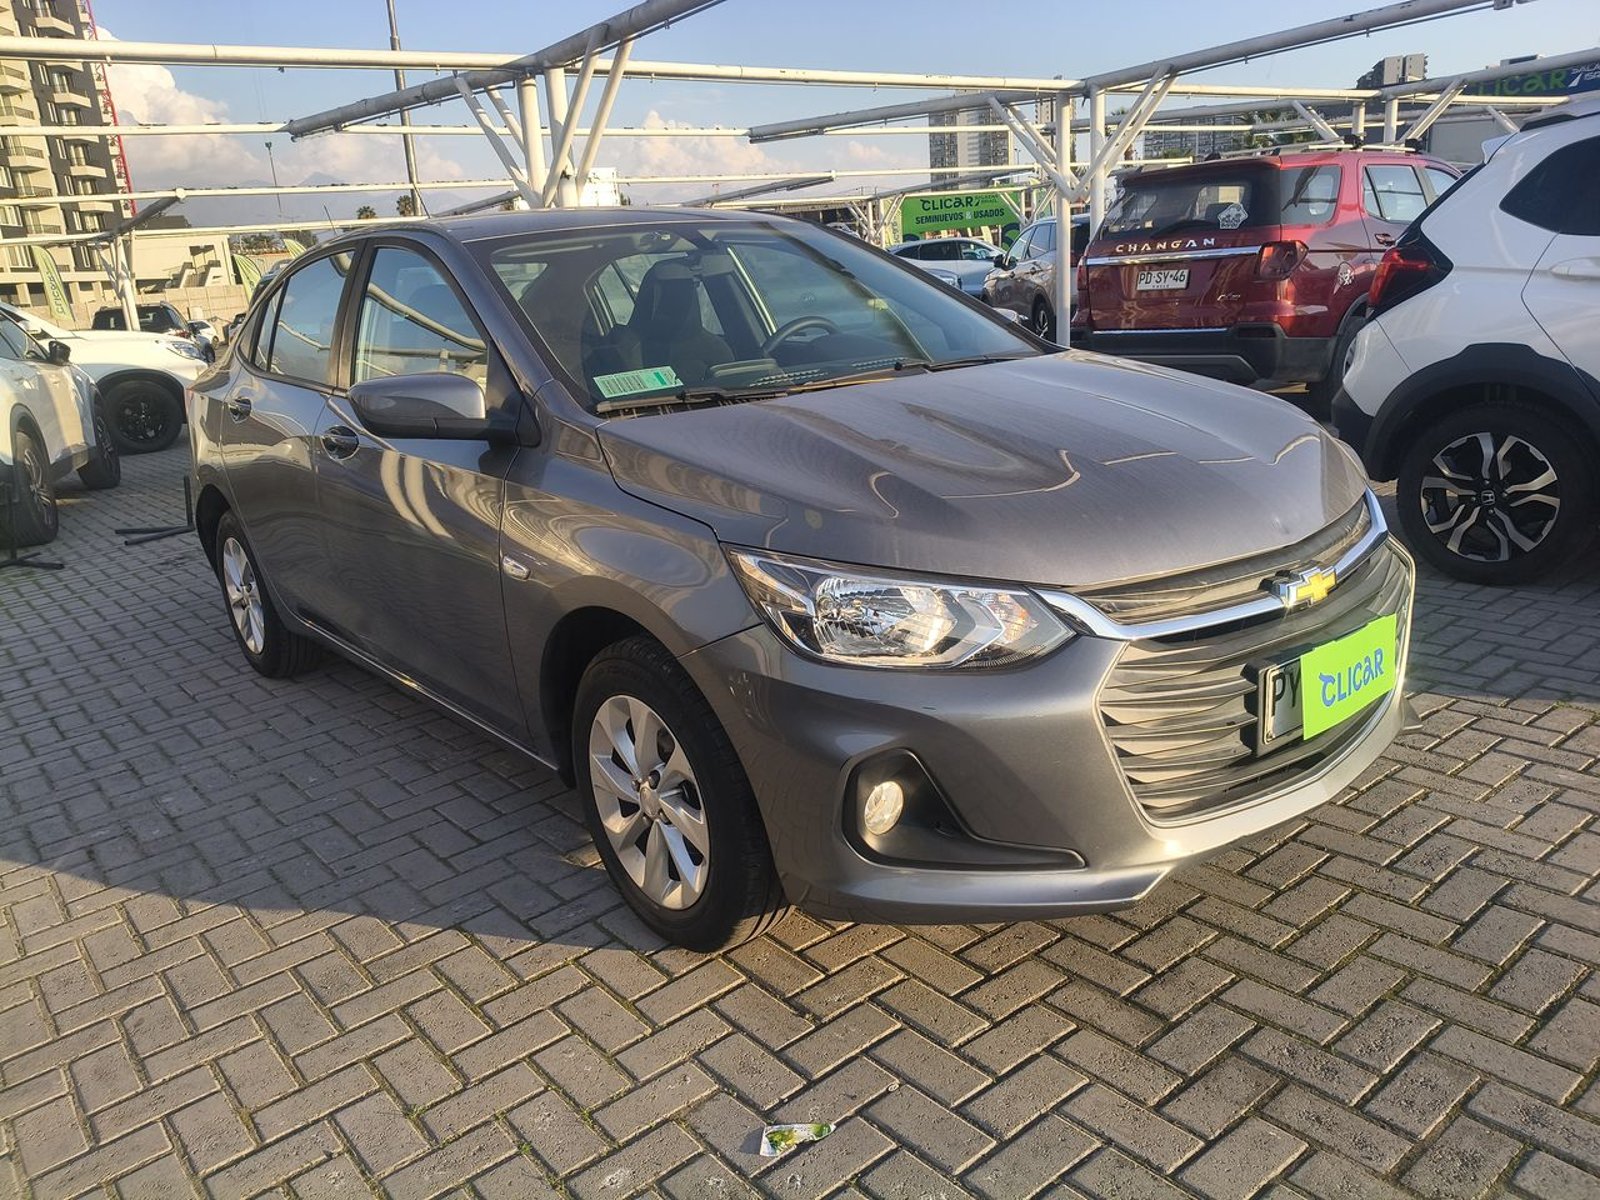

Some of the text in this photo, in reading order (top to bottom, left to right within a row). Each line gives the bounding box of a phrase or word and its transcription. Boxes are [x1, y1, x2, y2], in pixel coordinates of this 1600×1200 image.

[915, 212, 963, 225] SEMINUEVOS
[973, 208, 1005, 219] USADOS
[1115, 238, 1215, 253] CHANGAN
